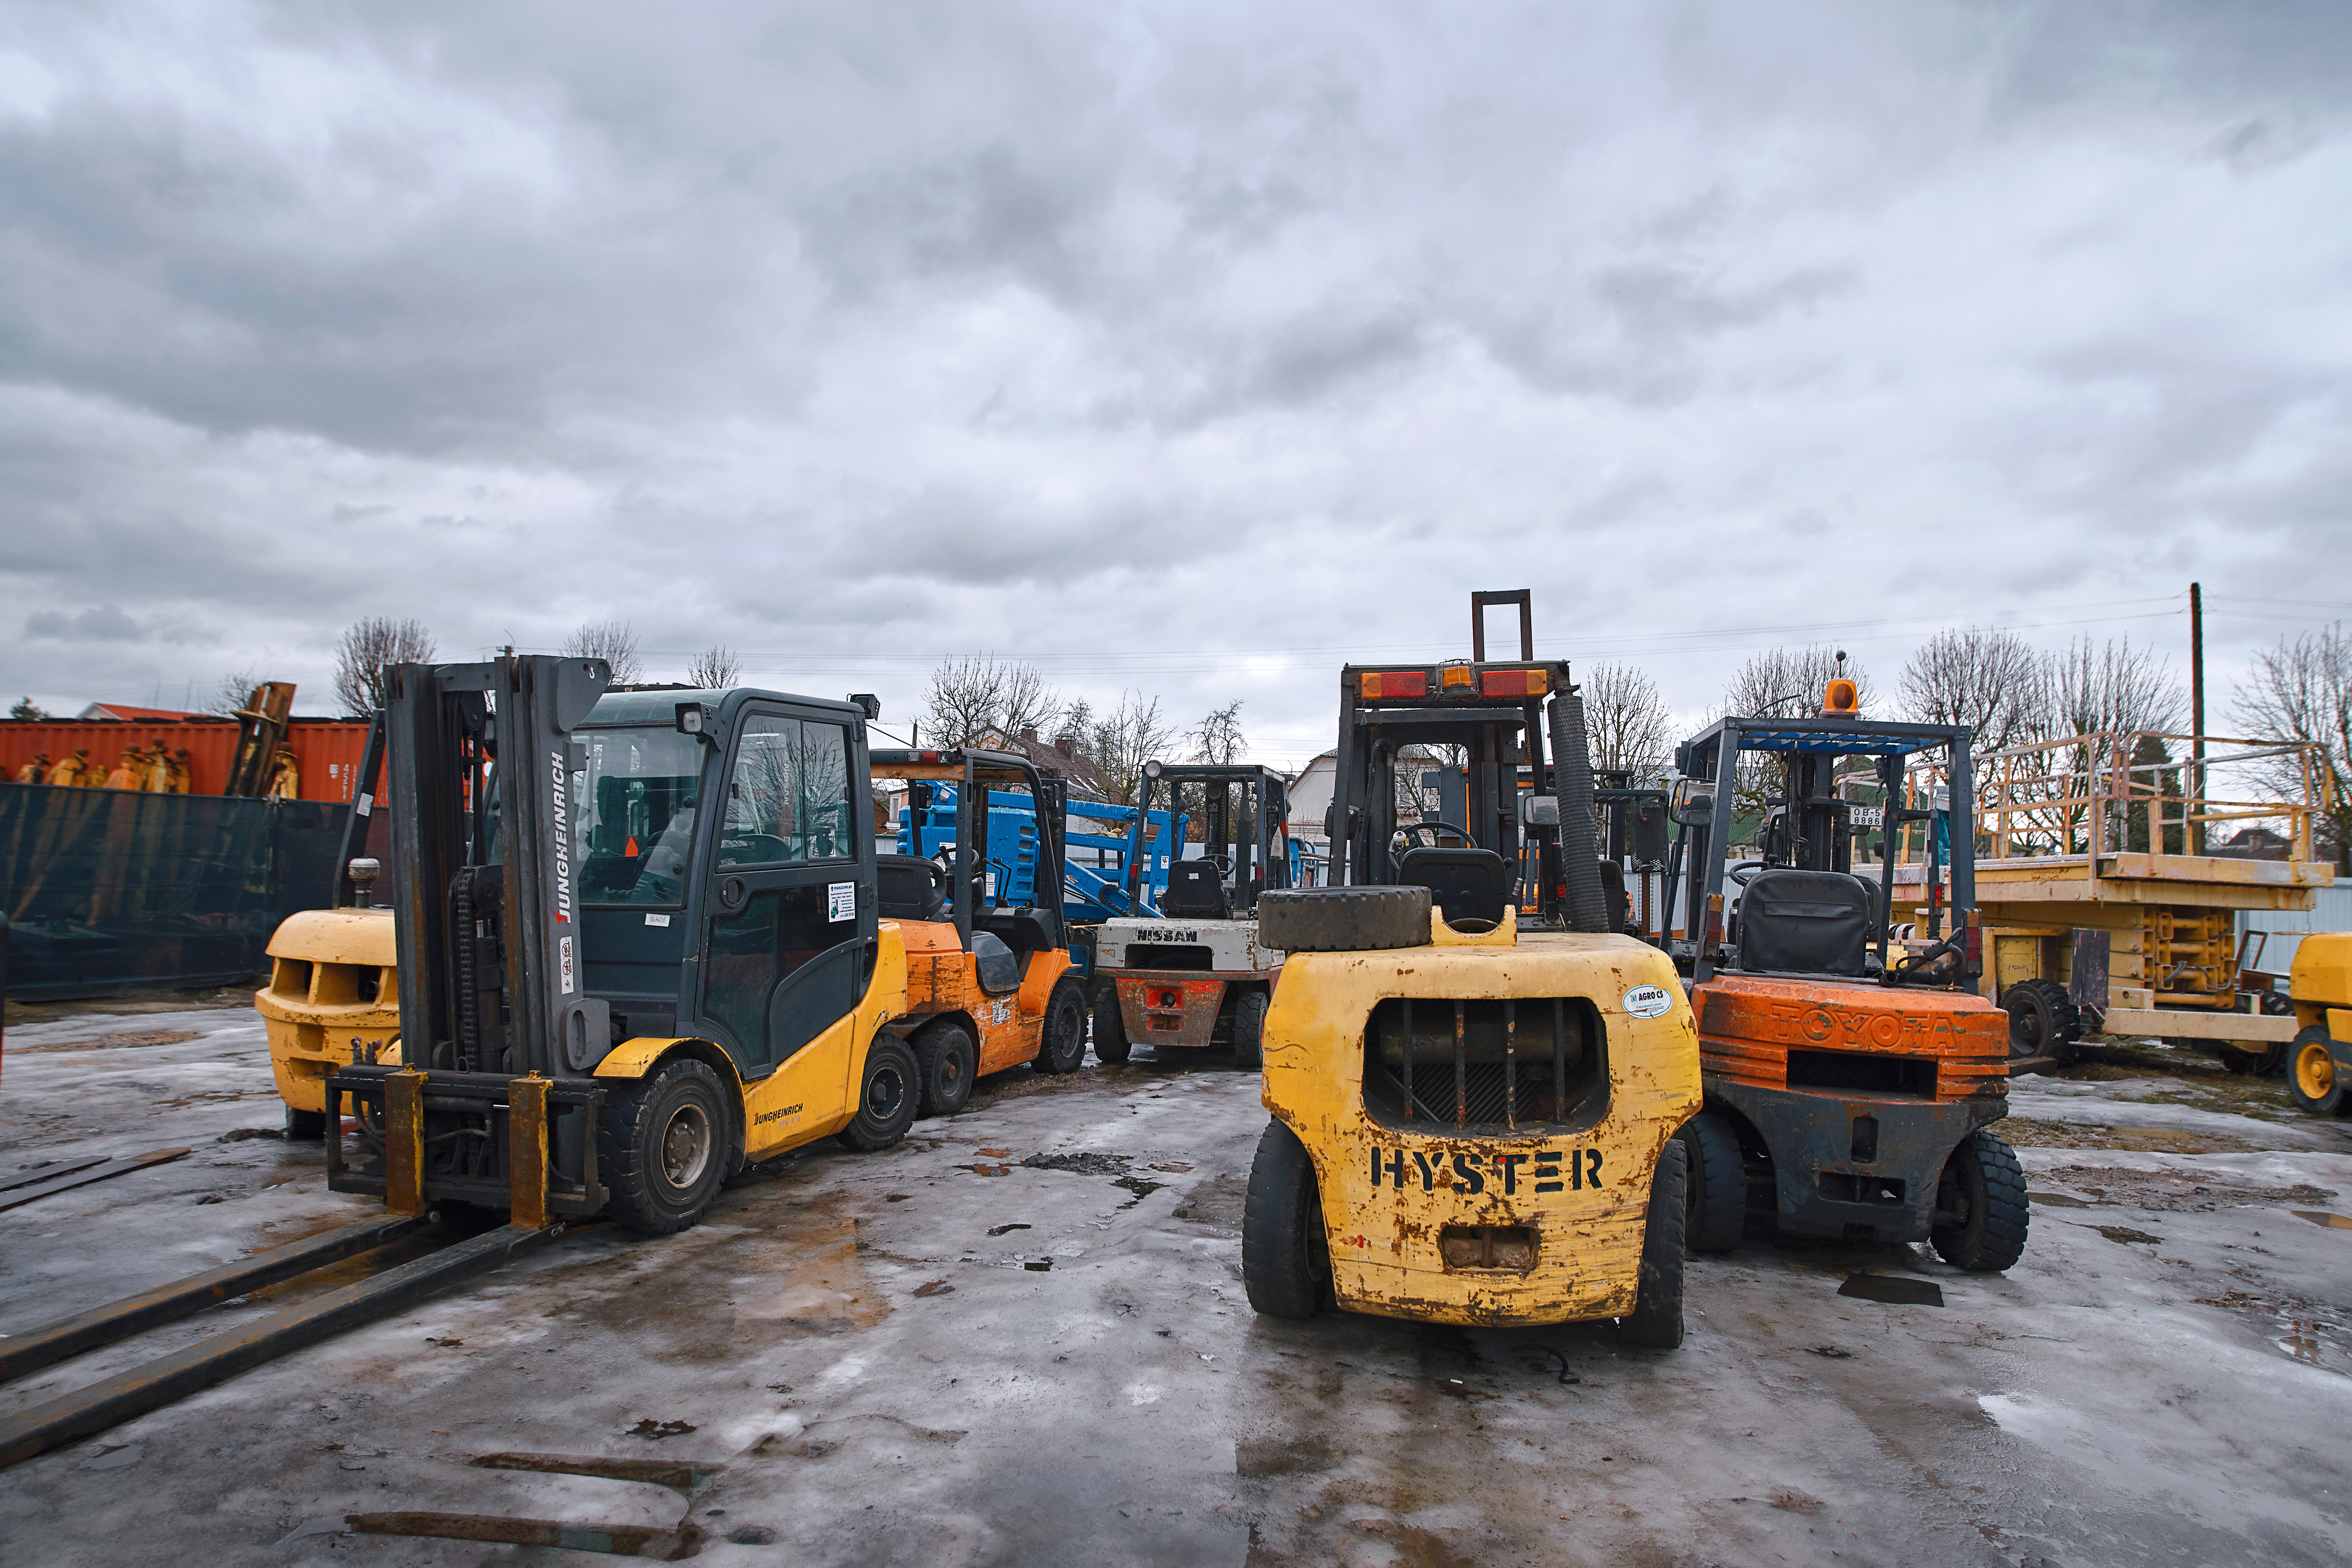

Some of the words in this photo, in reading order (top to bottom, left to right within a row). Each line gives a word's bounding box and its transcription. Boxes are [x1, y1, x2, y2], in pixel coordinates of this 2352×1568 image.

[551, 751, 571, 924] JUNGHEINRICH
[1137, 929, 1197, 942] NISSAN
[1639, 991, 1655, 1001] AGRO
[1770, 1003, 1958, 1051] TOYOTA
[754, 1103, 803, 1125] JUNGHEINRICH
[1371, 1147, 1603, 1196] HYSTER
